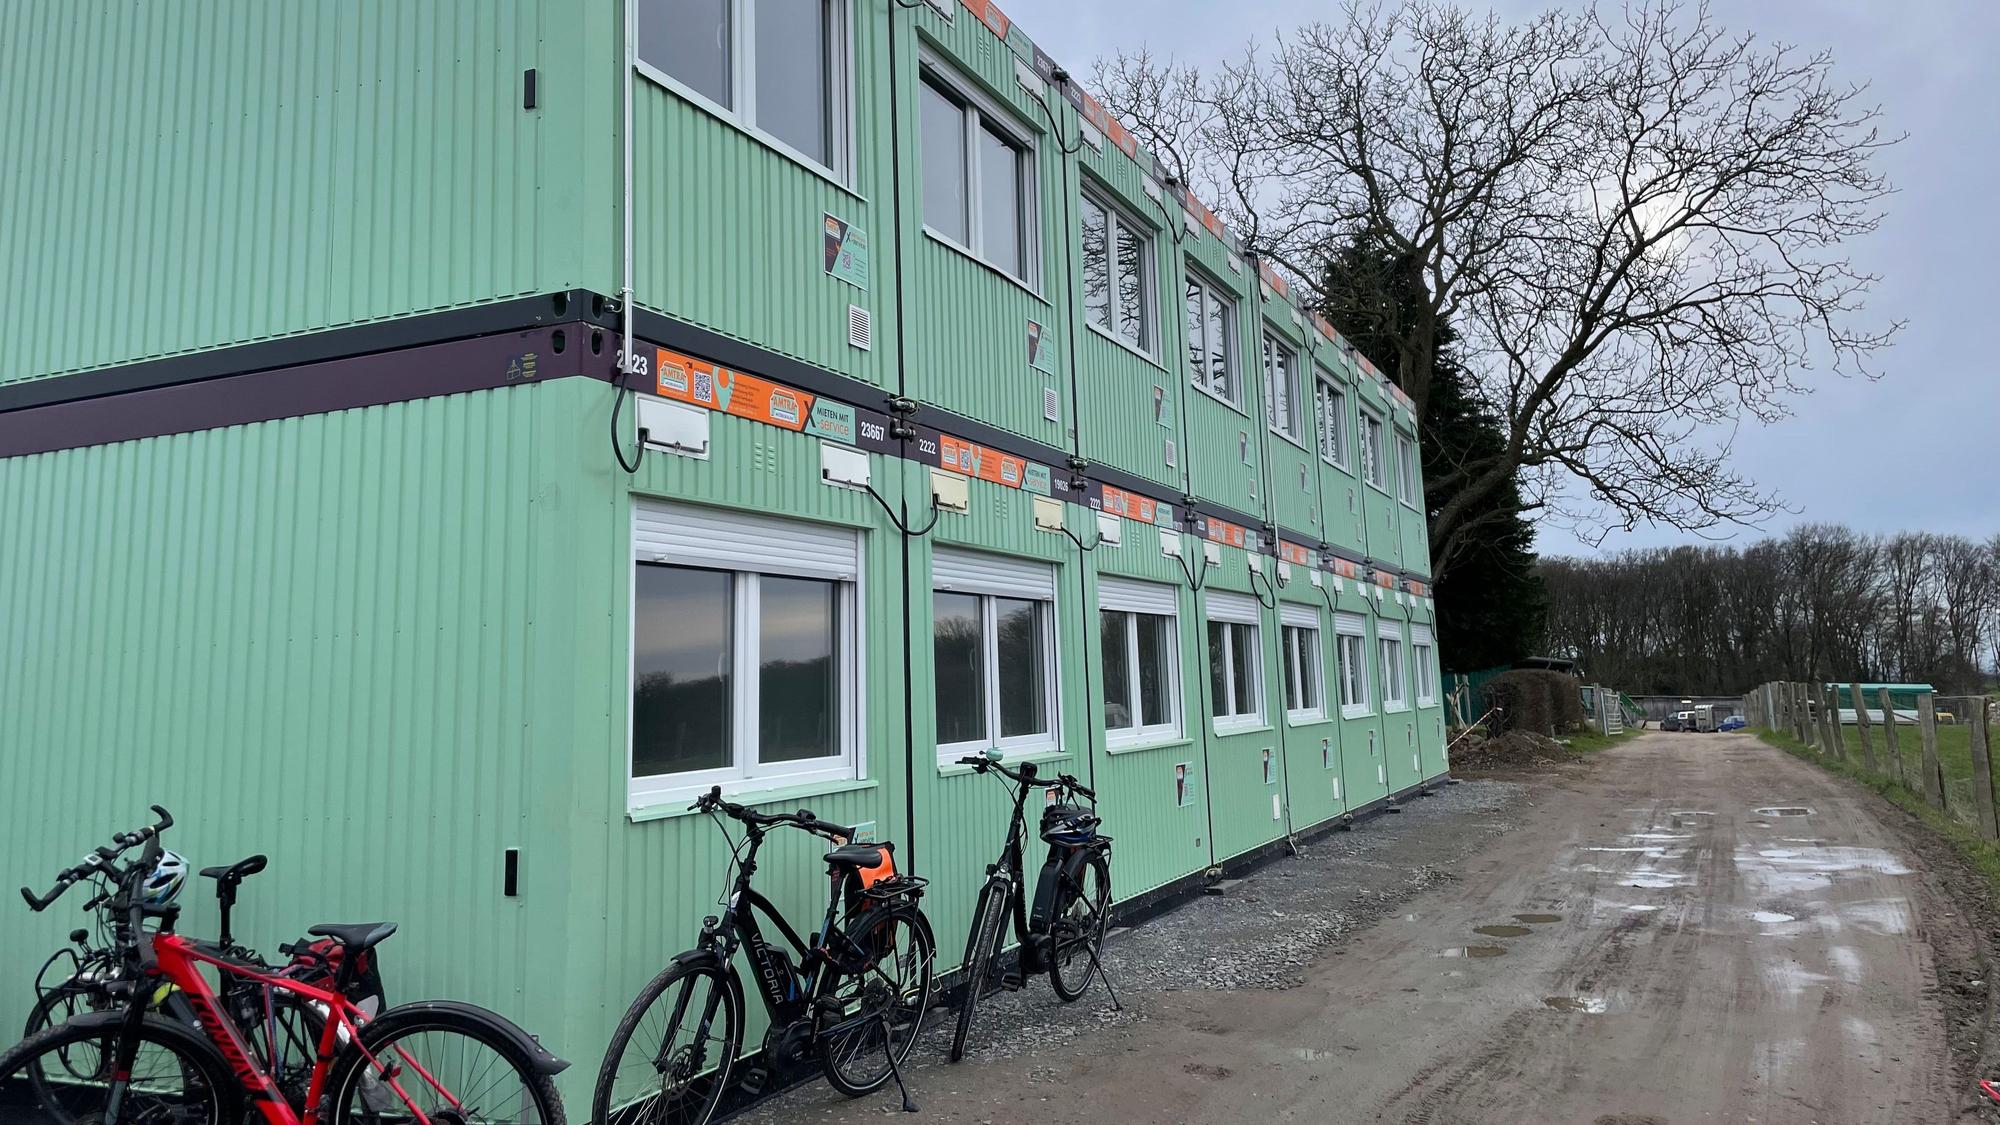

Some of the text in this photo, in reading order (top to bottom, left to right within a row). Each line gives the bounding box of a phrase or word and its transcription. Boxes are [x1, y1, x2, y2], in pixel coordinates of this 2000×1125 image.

[616, 349, 648, 376] 223
[816, 407, 849, 423] MIETEN MIT
[861, 421, 885, 442] 23667
[919, 438, 936, 455] 2222
[751, 932, 784, 1005] VICTORIA
